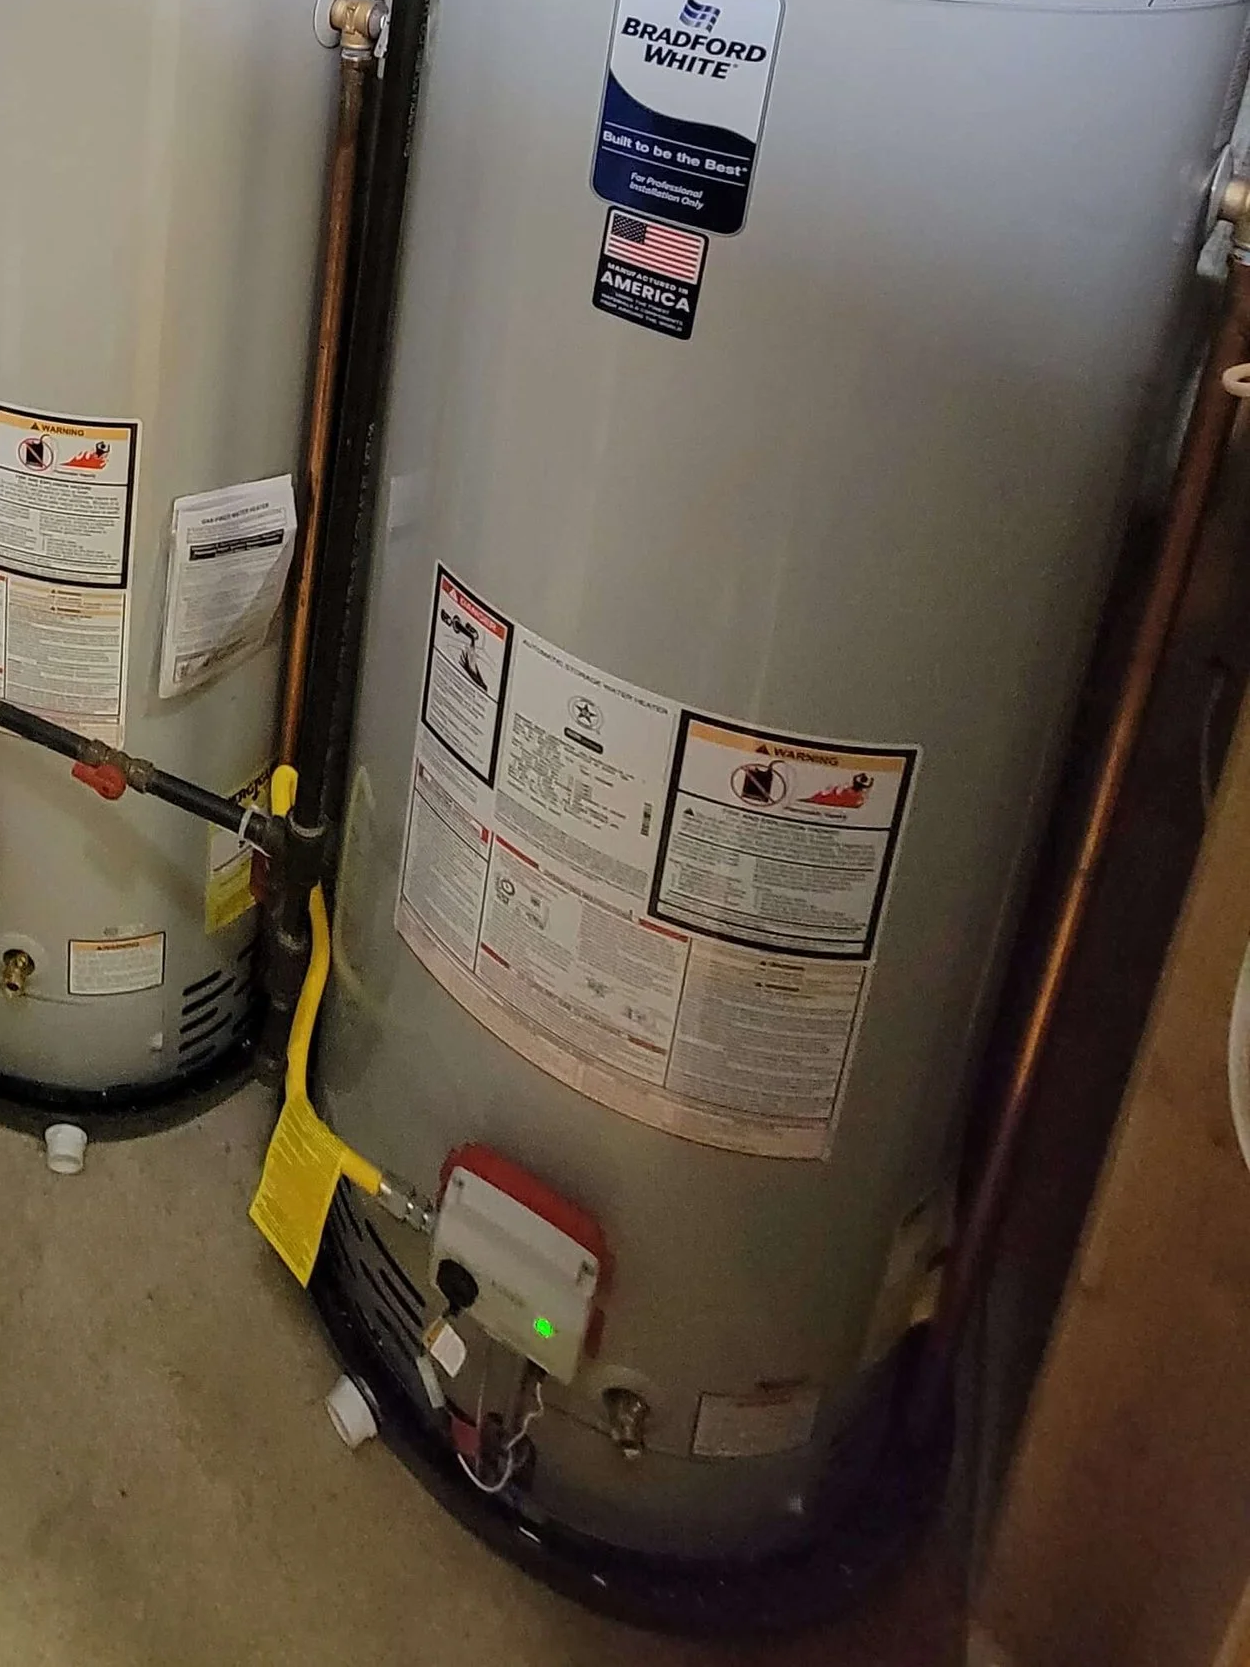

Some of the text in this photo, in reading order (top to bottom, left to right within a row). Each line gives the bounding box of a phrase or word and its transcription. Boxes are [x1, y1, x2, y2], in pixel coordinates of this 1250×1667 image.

[621, 17, 767, 63] BRADFORD
[644, 44, 731, 80] WHITE
[602, 130, 742, 177] Built to be the Best
[629, 181, 705, 210] Installation Only
[630, 172, 704, 199] For Professional
[607, 262, 677, 291] MANUFACTURED
[600, 270, 690, 313] AMERICA
[42, 424, 85, 436] WARNING
[773, 746, 839, 767] WARNING
